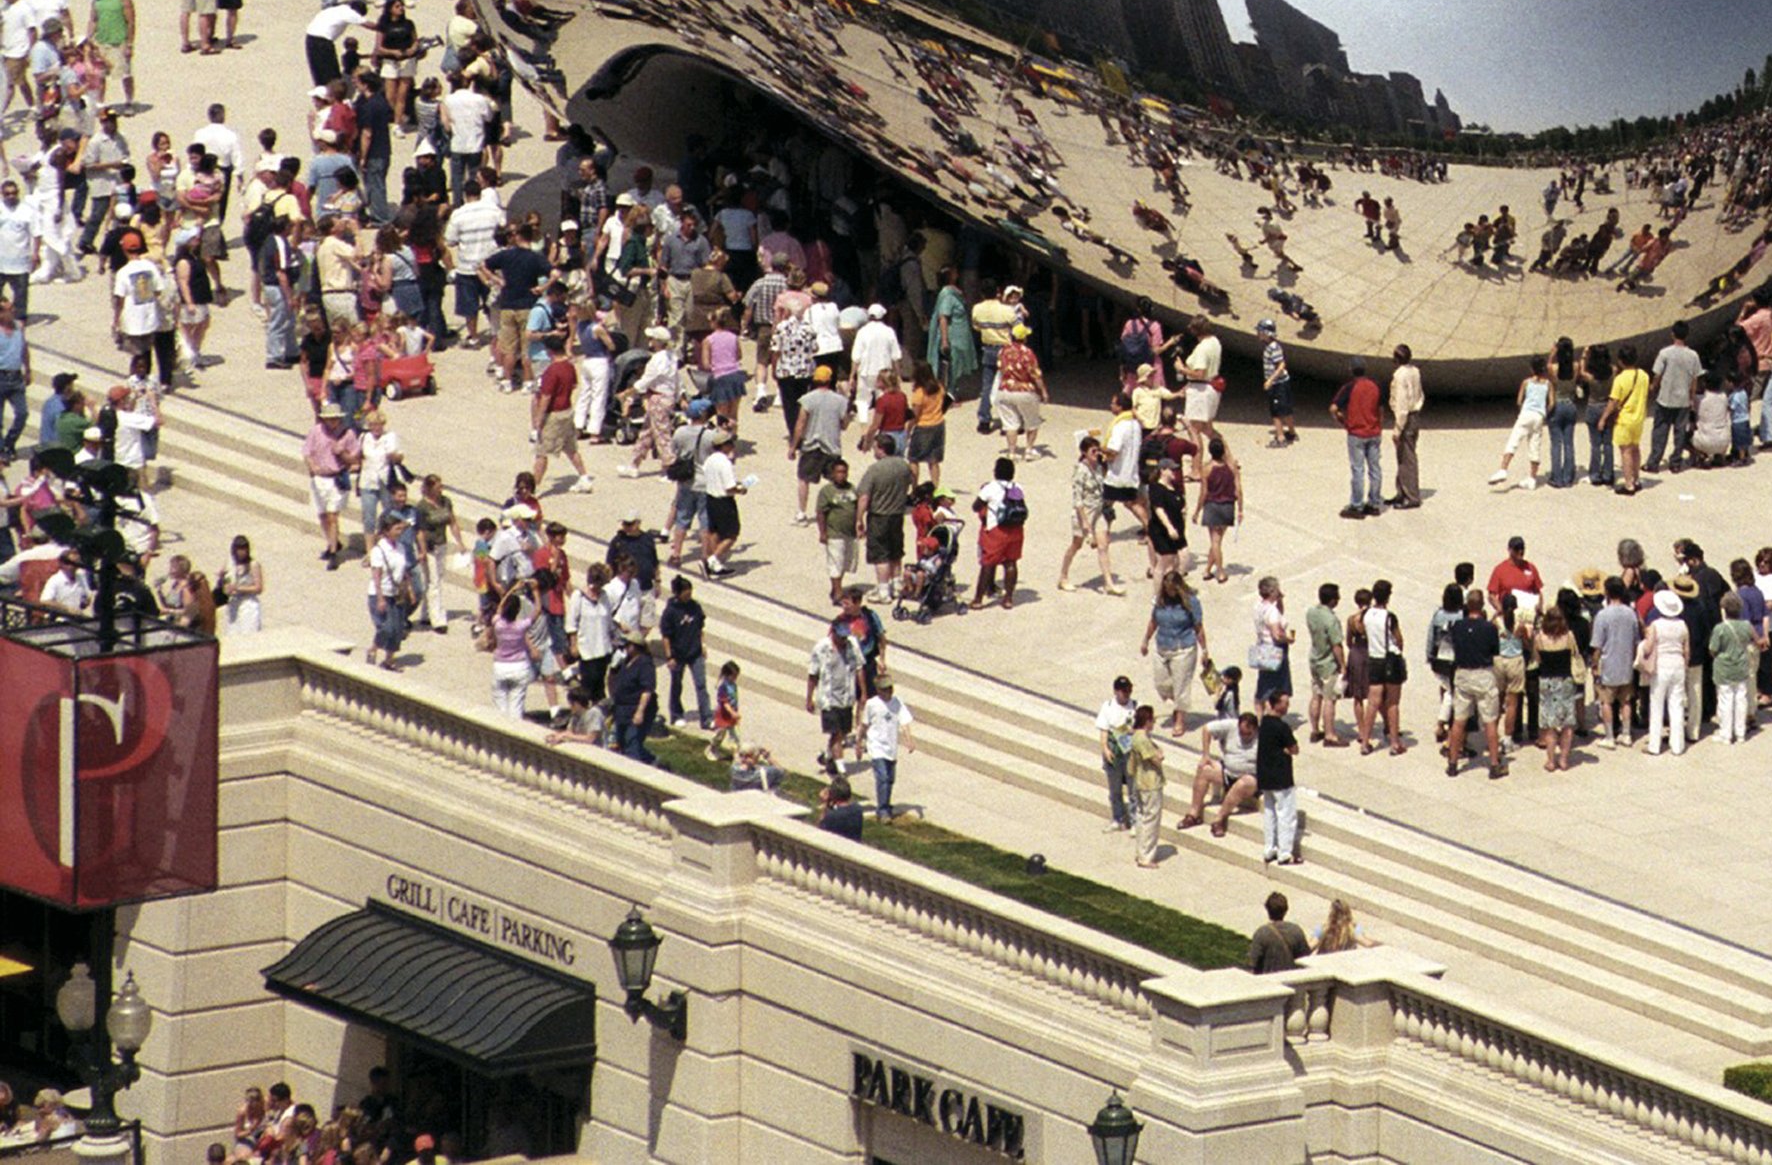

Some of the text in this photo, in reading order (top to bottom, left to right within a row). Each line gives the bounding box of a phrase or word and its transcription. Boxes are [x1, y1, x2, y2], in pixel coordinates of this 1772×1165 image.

[387, 873, 575, 965] GRILL CAFE PARKING
[851, 1051, 937, 1127] PARK
